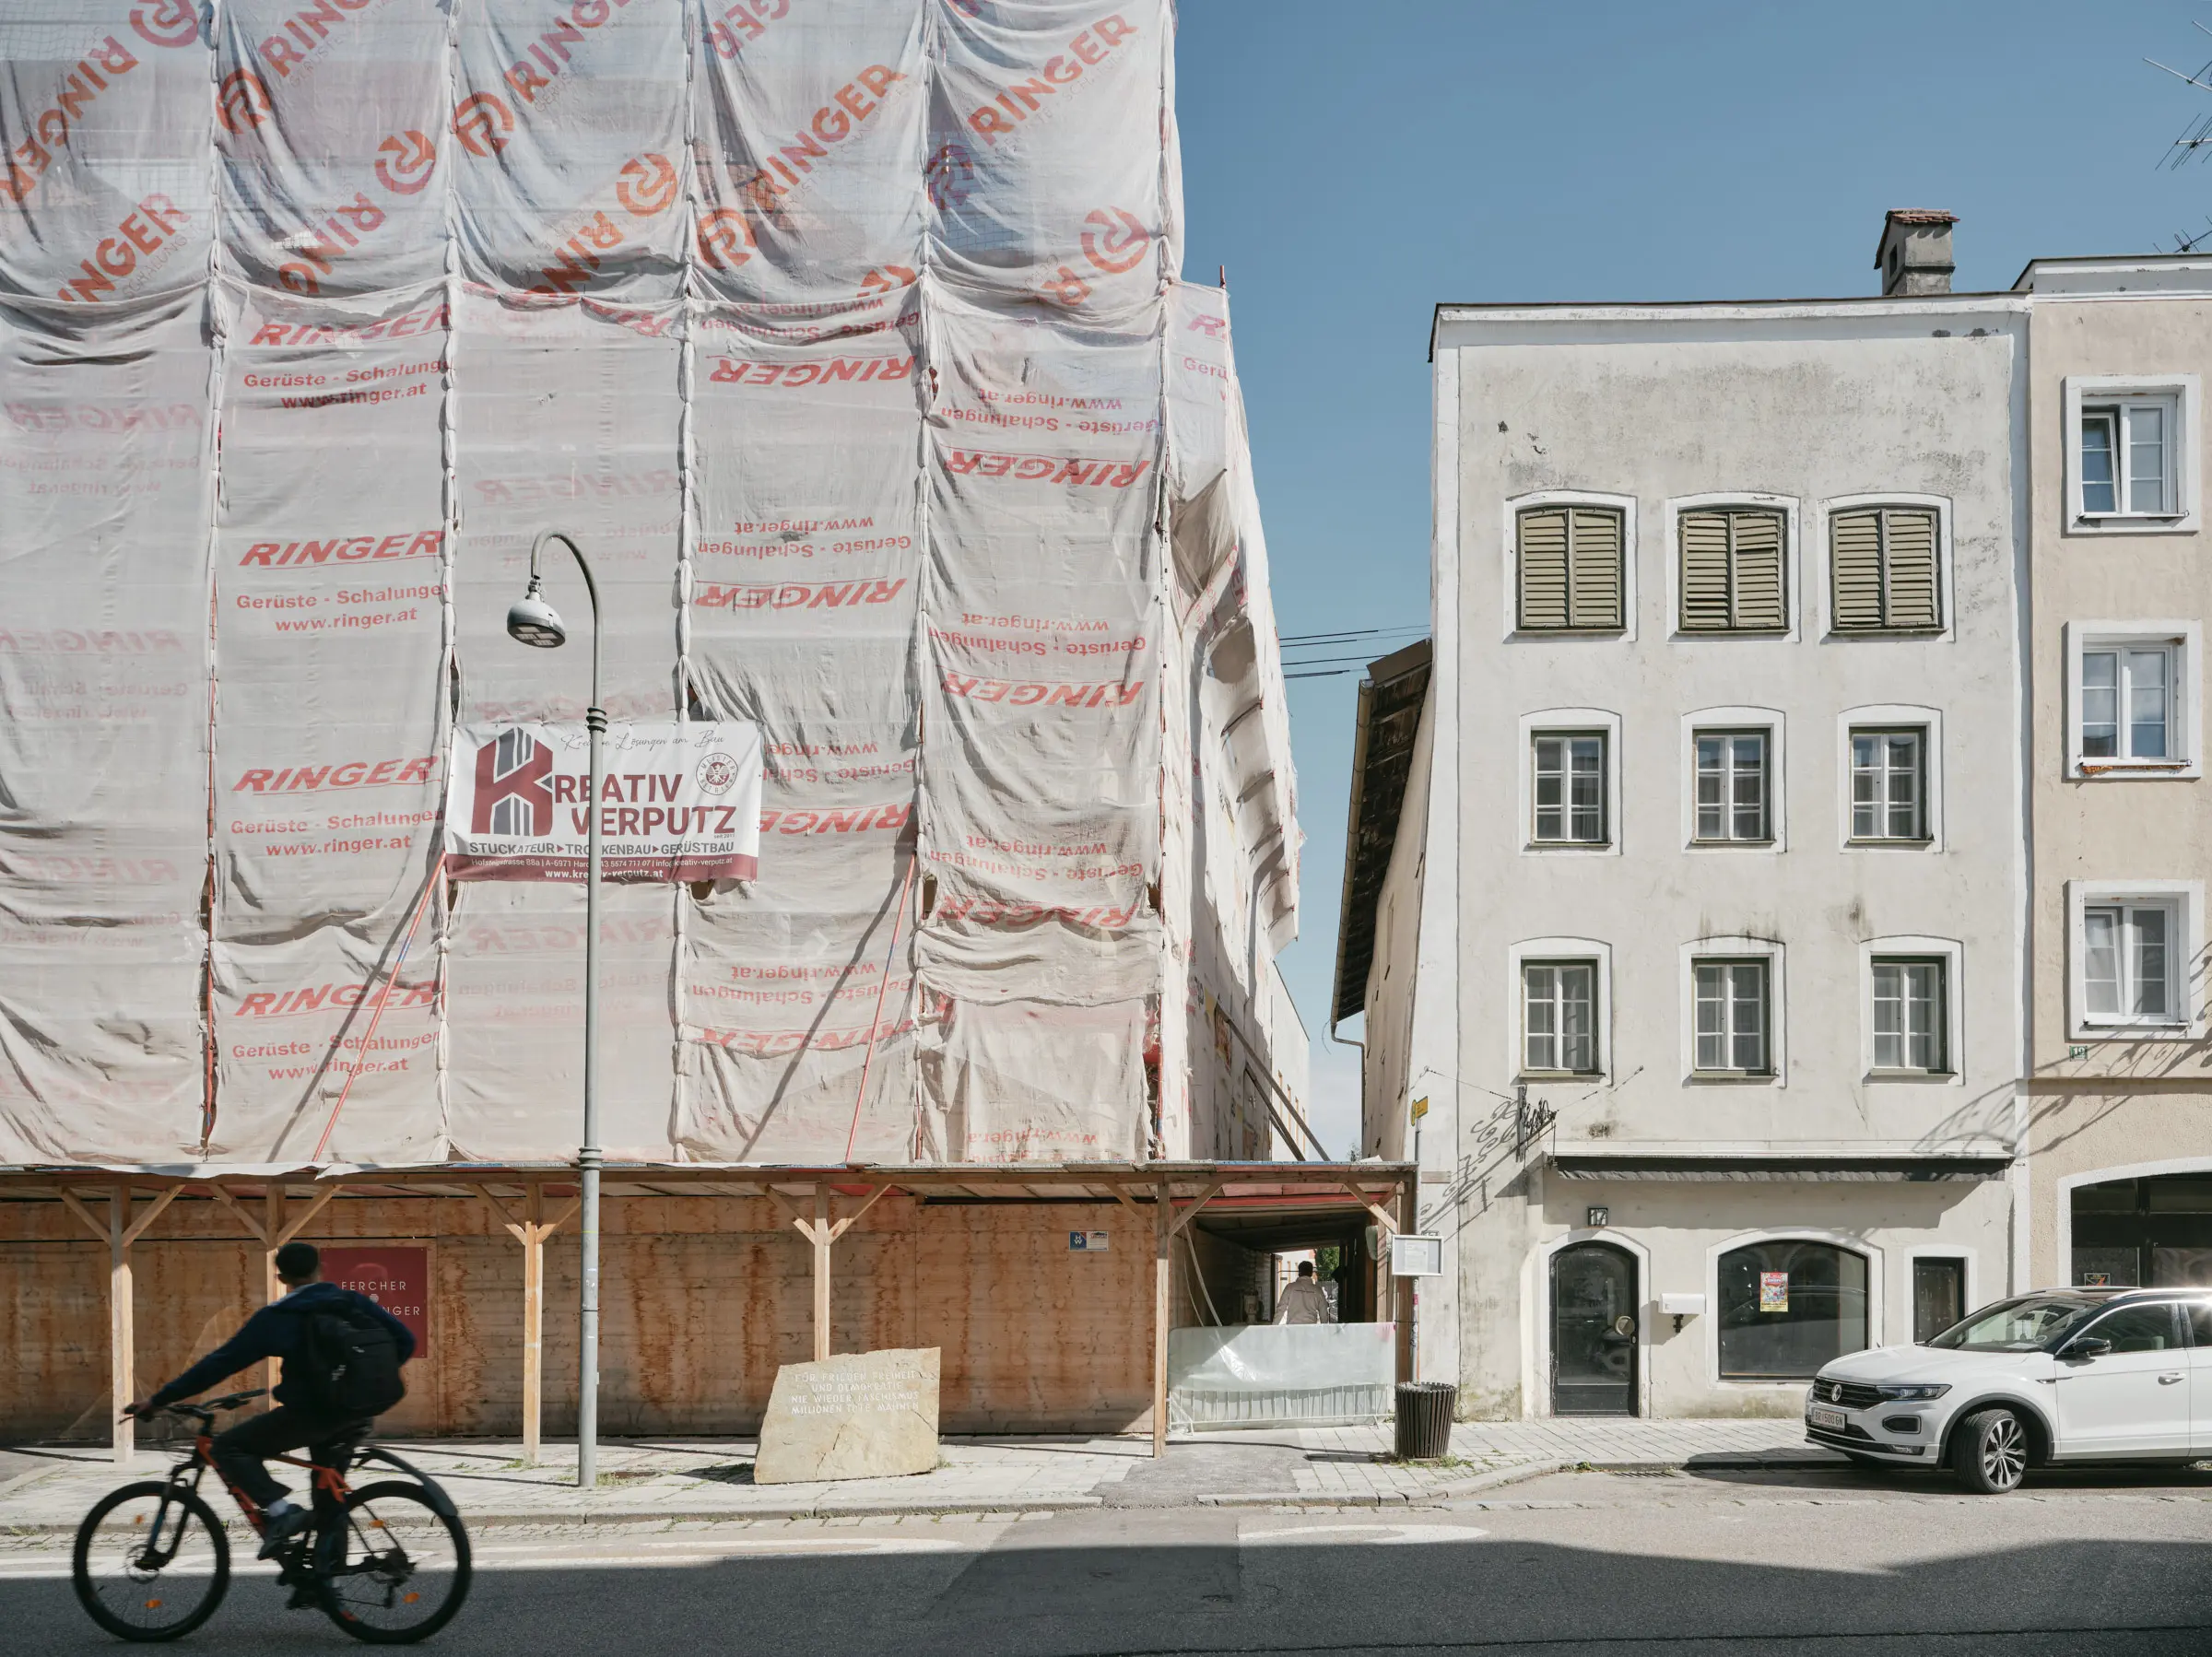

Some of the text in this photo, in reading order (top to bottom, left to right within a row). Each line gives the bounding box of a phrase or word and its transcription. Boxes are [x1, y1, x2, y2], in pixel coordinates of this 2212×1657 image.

[504, 0, 631, 103] RING
[968, 14, 1139, 147] RINGER
[57, 193, 192, 302] NGER
[244, 360, 452, 387] Gerüste Schalung
[709, 355, 918, 387] RINGER
[1183, 357, 1227, 379] Gerü
[979, 388, 1122, 410] www.ringer.at
[941, 406, 1059, 430] Schalungen
[945, 451, 1151, 488] RINGER
[735, 516, 874, 535] www.ringer.at
[238, 531, 446, 566] RINGER
[698, 535, 912, 560] Gerüste Schalungen
[237, 593, 317, 609] Gerüste
[694, 578, 907, 609] RINGER
[276, 607, 418, 631] www.ringer.at
[961, 612, 1109, 632] www.ringer.at
[929, 627, 1147, 656] Gerüste Schalungen
[616, 733, 667, 751] Lösungen
[694, 730, 724, 747] Bau
[232, 756, 439, 791] RINGER
[231, 819, 307, 834] Gerüste
[571, 806, 736, 836] VERPUTZ
[759, 802, 913, 835] RINGE
[266, 835, 412, 856] www.ringer.at
[470, 840, 734, 855] STUCKATEUR TRKENBAU GERÜSTBAU
[545, 869, 664, 879] www.krev-verputz.at
[732, 962, 877, 981] www.ringer.at
[235, 981, 438, 1017] RINGER
[692, 977, 914, 1005] Geüste Schalungen
[232, 1040, 311, 1058] Gerüste
[968, 1128, 1099, 1144] www.ringer.a
[341, 1281, 406, 1291] FERCHER
[382, 1306, 420, 1316] NGER
[791, 1394, 808, 1404] NIE
[814, 1393, 853, 1403] WIEDER
[811, 1383, 833, 1393] UND
[791, 1404, 842, 1415] MILLIONEN
